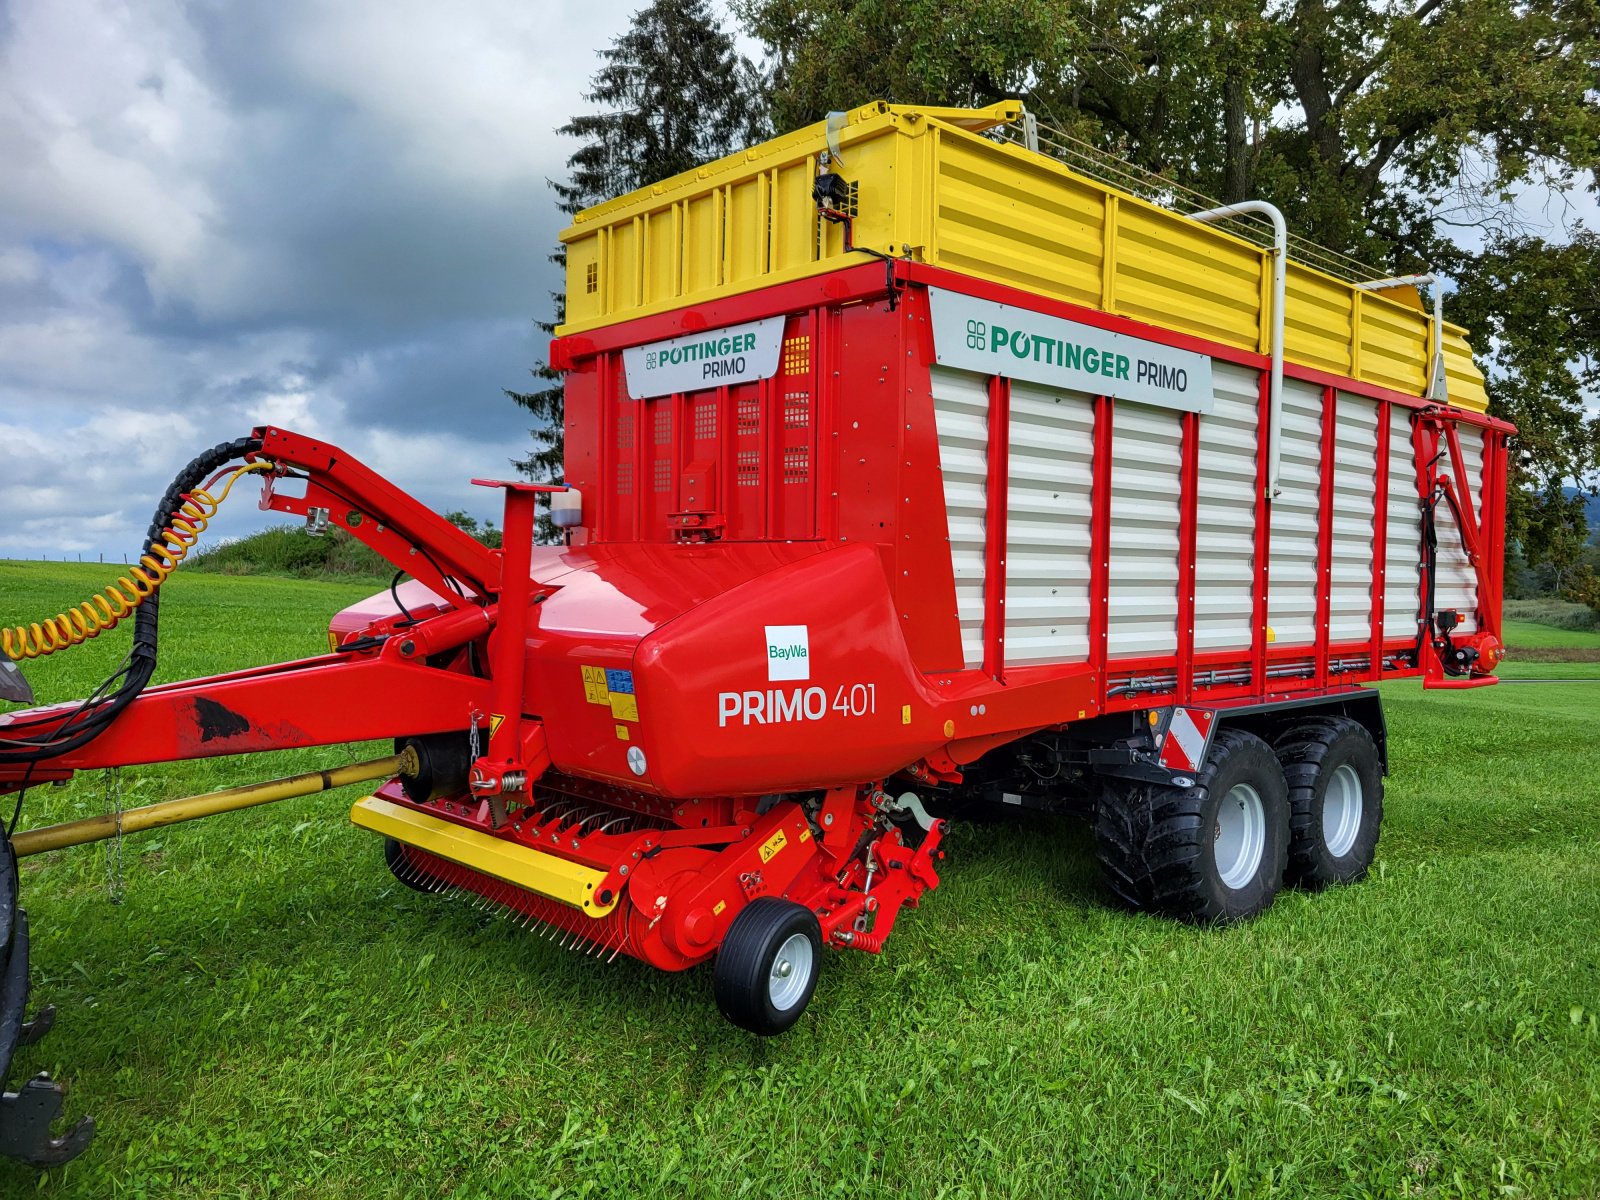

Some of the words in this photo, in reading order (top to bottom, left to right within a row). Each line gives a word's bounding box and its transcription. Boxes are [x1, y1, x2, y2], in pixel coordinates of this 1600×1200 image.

[659, 332, 756, 368] PÖTTINGER
[703, 356, 746, 380] PRIMO
[991, 325, 1130, 381] PÖTTINGER
[1136, 359, 1188, 393] PRIMO
[769, 645, 807, 660] BayWa
[718, 686, 827, 728] PRIMO
[832, 683, 875, 717] 401
